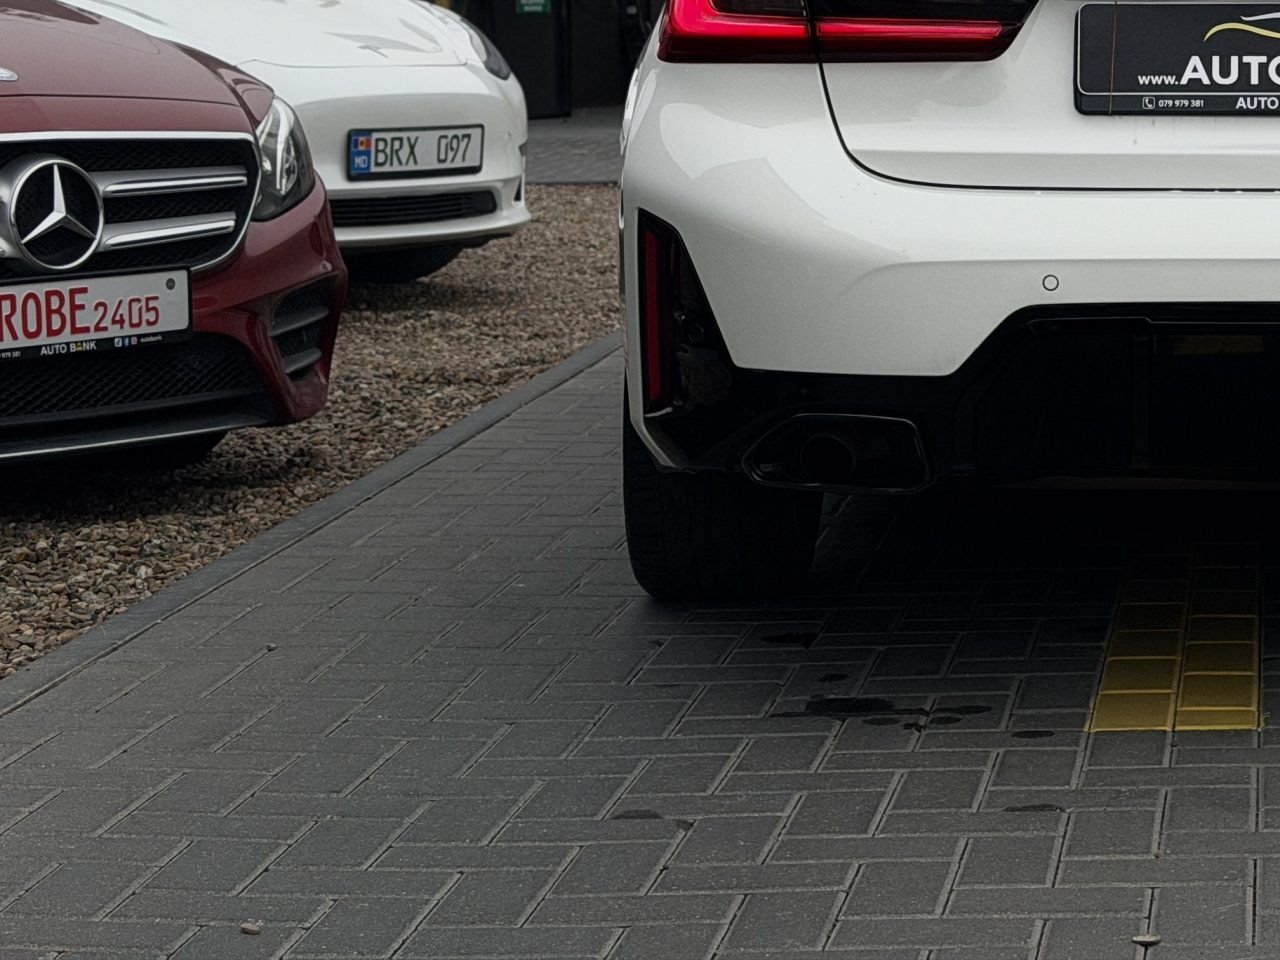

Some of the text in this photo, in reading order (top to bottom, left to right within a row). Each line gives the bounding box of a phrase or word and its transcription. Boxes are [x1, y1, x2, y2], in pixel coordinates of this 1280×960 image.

[1158, 99, 1204, 108] 079 979 381
[1235, 97, 1279, 110] AUTO
[374, 133, 472, 167] BRX 097
[354, 156, 369, 168] MD
[0, 287, 160, 342] ROBE 2405
[40, 344, 67, 356] AUTO
